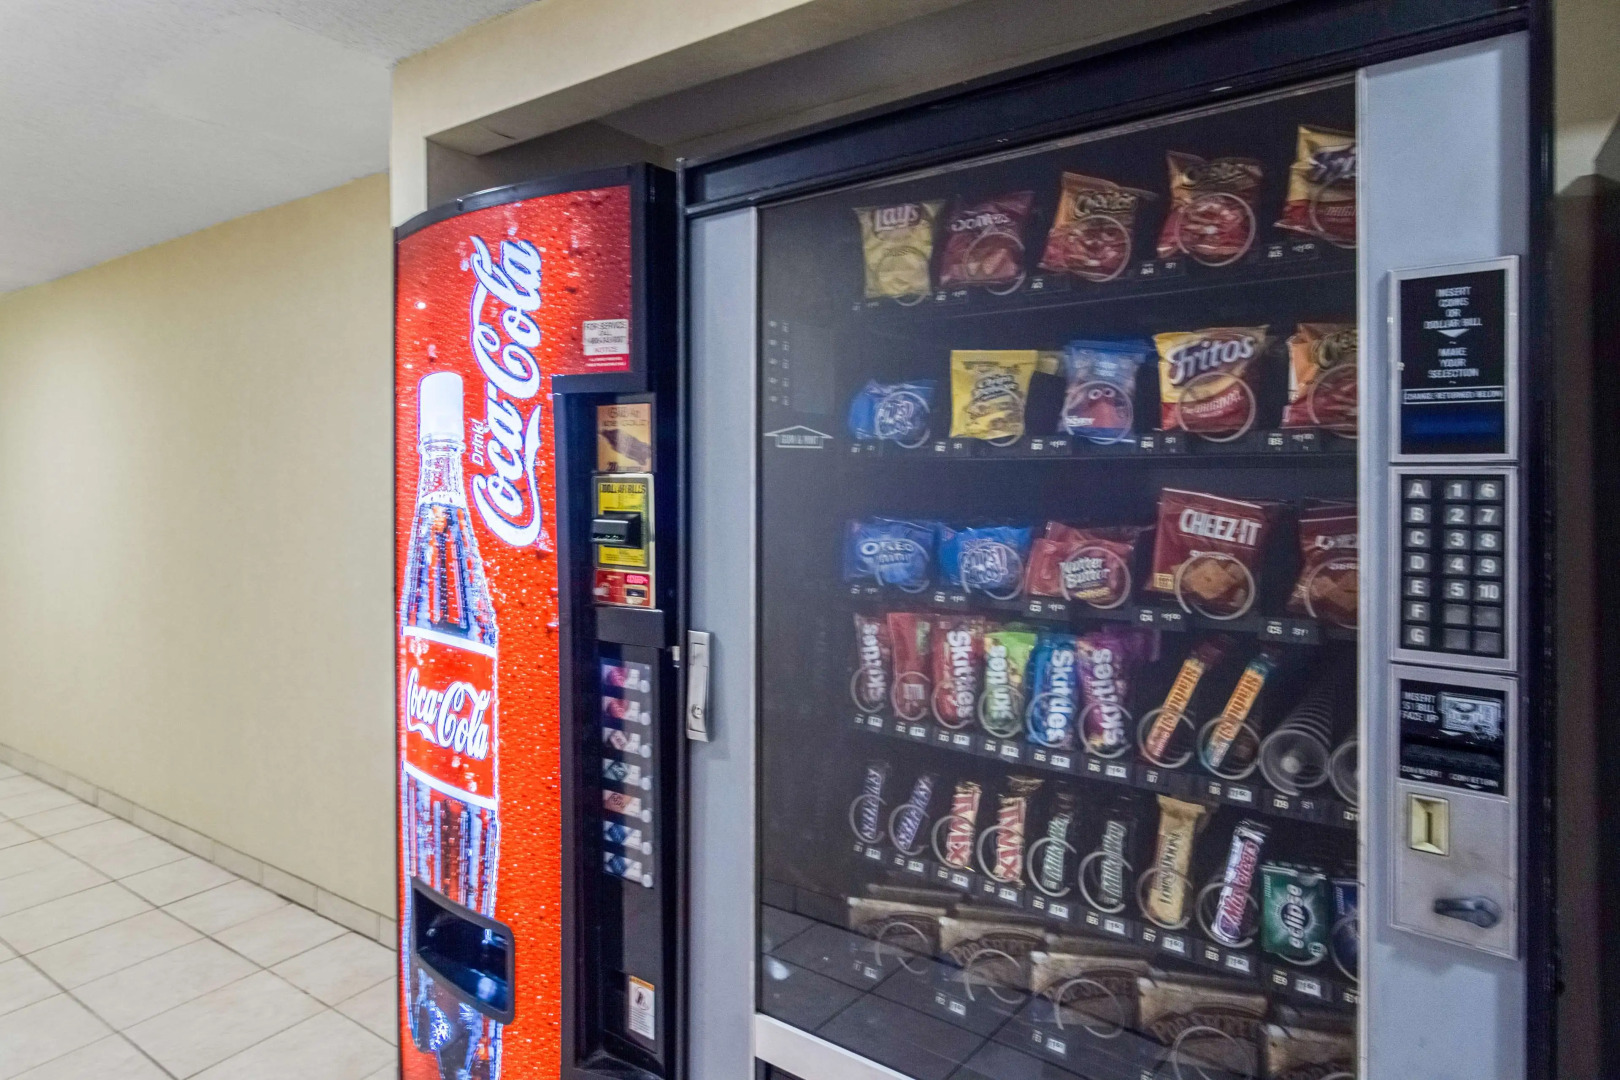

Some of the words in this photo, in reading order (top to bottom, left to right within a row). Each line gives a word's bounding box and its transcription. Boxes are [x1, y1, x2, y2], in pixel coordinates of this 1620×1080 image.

[1435, 287, 1472, 297] INSERT
[1438, 298, 1470, 307] COINS
[1445, 309, 1461, 317] OR
[1423, 319, 1460, 329] DOLLAR
[1462, 317, 1483, 326] BILL
[1437, 347, 1468, 356] MAKE
[1165, 336, 1255, 385] Fritos
[1438, 358, 1467, 367] YOUR
[1427, 368, 1480, 378] SELECTION
[470, 235, 542, 547] Coca-Cola
[1409, 483, 1425, 497] A
[1451, 483, 1462, 496] 1
[1481, 483, 1496, 497] 6
[1411, 507, 1424, 521] B
[1450, 508, 1465, 522] 2
[1481, 508, 1495, 523] 7
[1179, 508, 1263, 546] CHEEZ-IT
[1411, 531, 1425, 545] C
[1450, 532, 1465, 547] 3
[1481, 533, 1496, 548] 8
[861, 538, 914, 555] OREO
[1411, 555, 1425, 569] D
[1451, 557, 1465, 571] 4
[1481, 559, 1496, 573] 9
[1065, 569, 1110, 588] Butter
[1411, 580, 1424, 594] E
[1450, 582, 1465, 597] 5
[1478, 584, 1499, 599] 10
[1411, 604, 1424, 618] F
[1411, 628, 1425, 643] G
[947, 630, 975, 718] Skittles
[987, 645, 1014, 720] Skittles
[1046, 649, 1074, 742] Skittles
[1092, 648, 1124, 746] Skittles
[1402, 692, 1436, 703] INSERT
[406, 670, 490, 760] Coca-Cola
[1402, 711, 1423, 721] FACE
[947, 793, 976, 863] TWIX
[999, 802, 1025, 878] TWIX
[1282, 884, 1306, 949] eclipse
